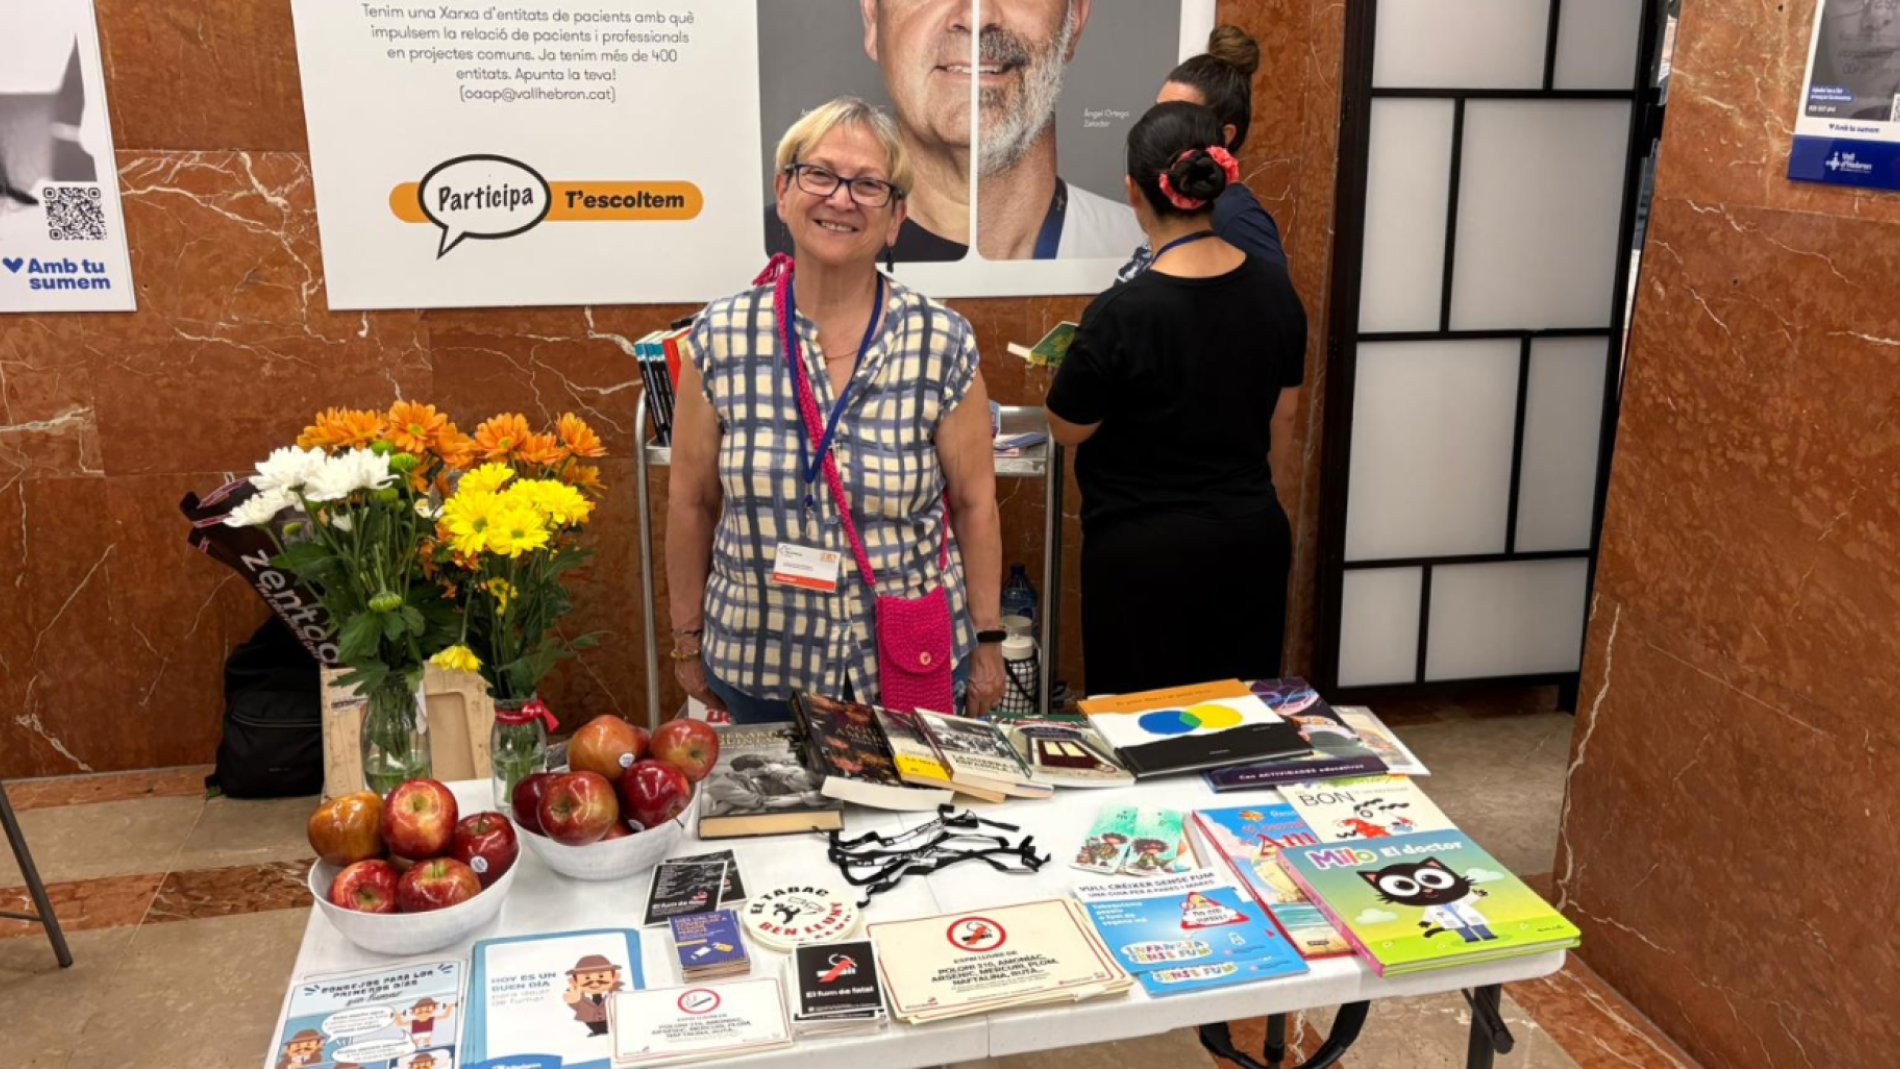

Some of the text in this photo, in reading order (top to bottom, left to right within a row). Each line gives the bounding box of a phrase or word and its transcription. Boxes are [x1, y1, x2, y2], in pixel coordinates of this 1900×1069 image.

[361, 3, 695, 27] Tenim una Xarxa d'entitats de pacients amb què
[371, 24, 440, 42] impulsem
[444, 26, 457, 39] la
[461, 27, 508, 40] relació
[511, 28, 529, 41] de
[533, 29, 592, 44] pacients
[602, 29, 690, 46] professionals
[387, 46, 677, 63] en projectes comuns. Ja tenim més de 400
[456, 67, 616, 83] entitats. Apunta la teva!
[438, 183, 685, 212] Participa T'escoltem
[27, 258, 105, 274] Amb tu
[29, 277, 111, 290] sumem
[1298, 790, 1357, 807] BON
[1307, 841, 1464, 869] Milo El doctor
[321, 979, 380, 994] CONSEJOS
[383, 973, 410, 984] PARA
[491, 971, 557, 985] HOY ES UN
[491, 983, 526, 993] BUEN
